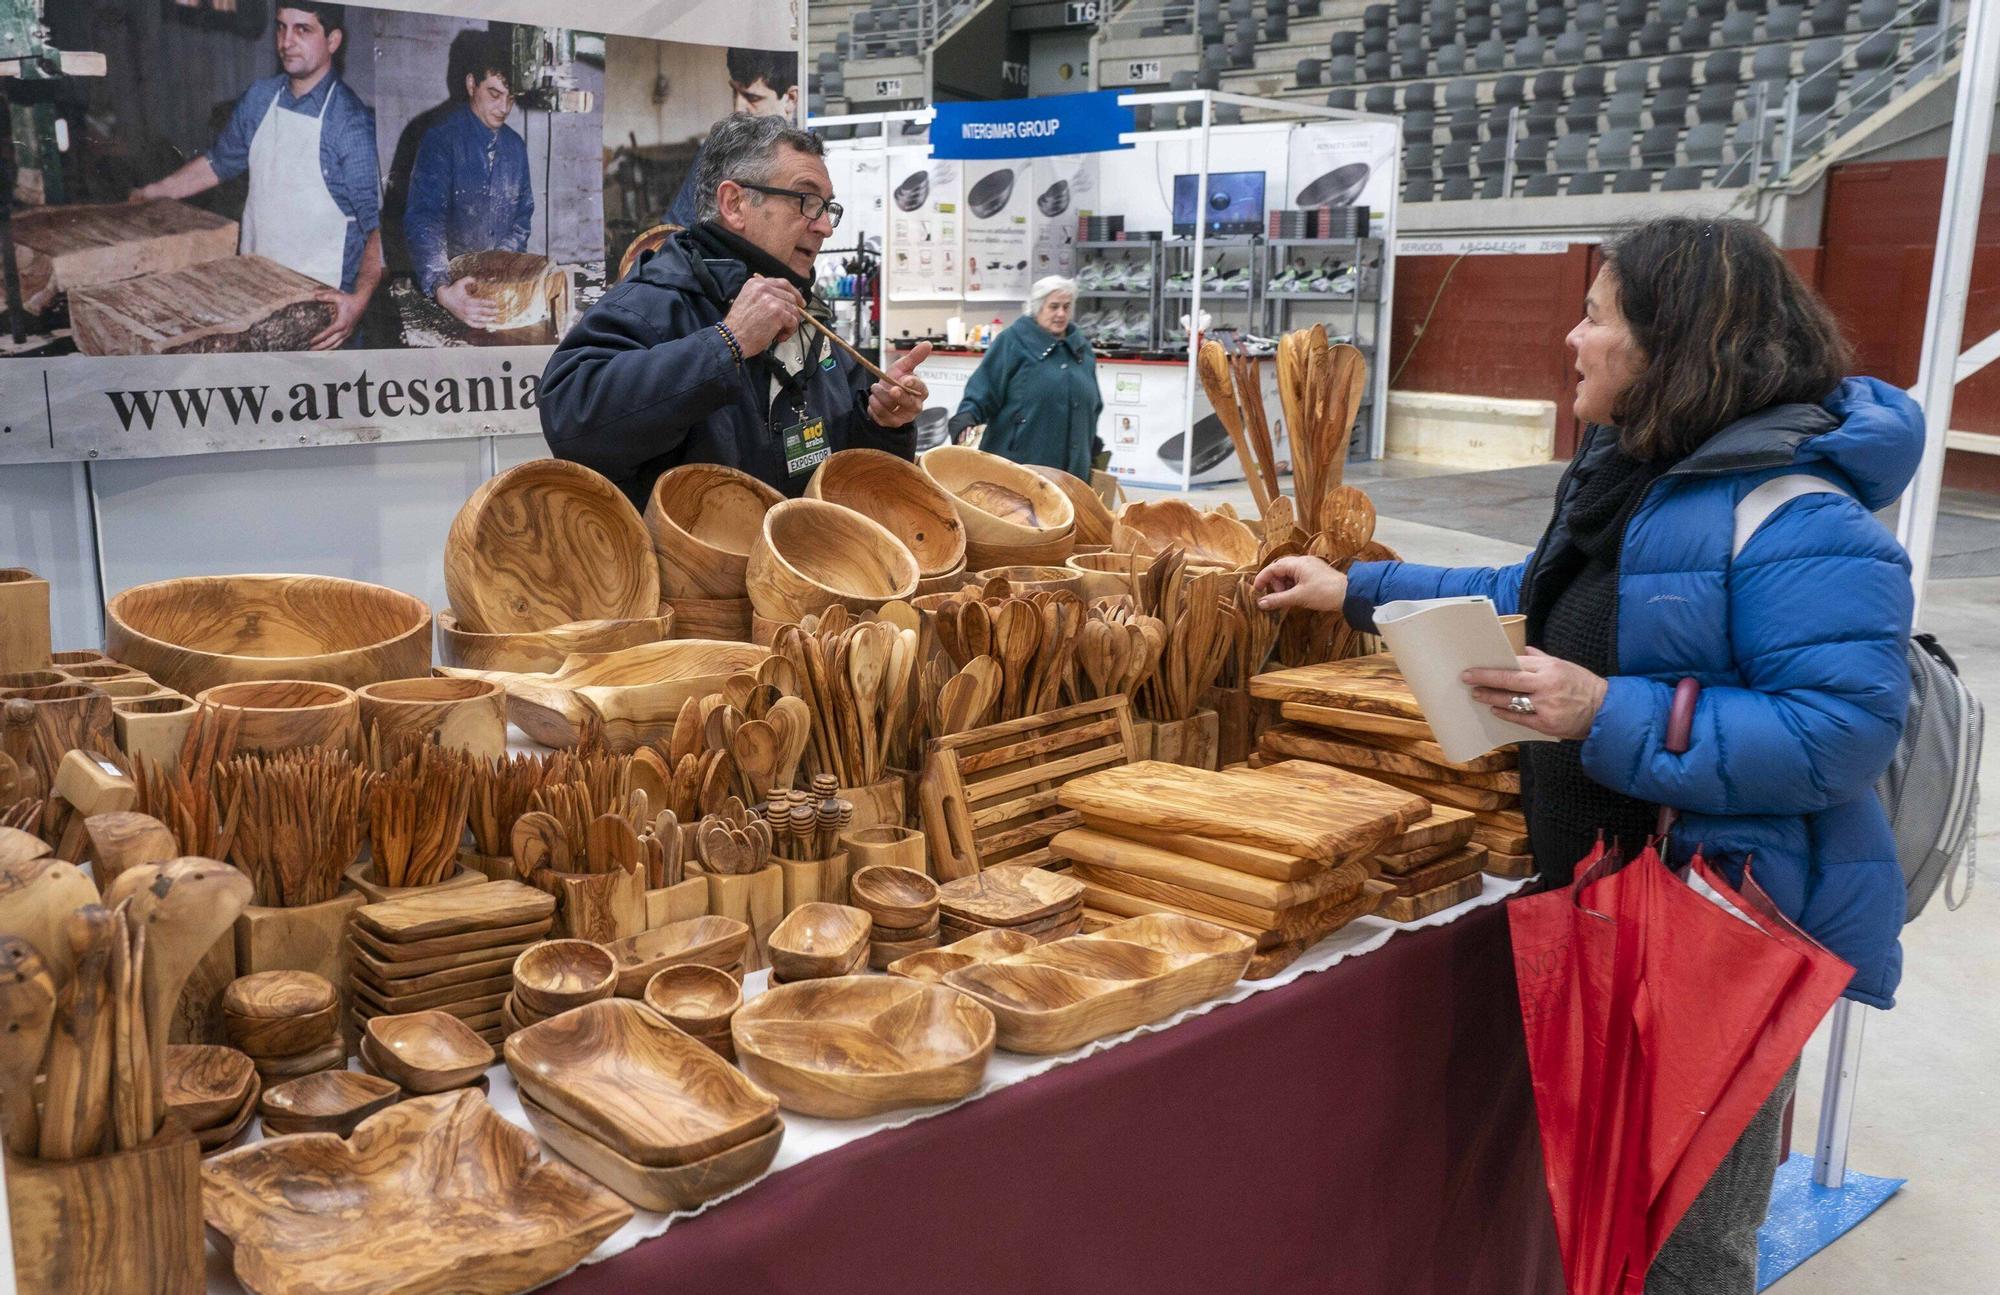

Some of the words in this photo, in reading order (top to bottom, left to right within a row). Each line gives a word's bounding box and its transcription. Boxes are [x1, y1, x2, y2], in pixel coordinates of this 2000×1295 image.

[1073, 3, 1096, 22] T6
[1145, 63, 1158, 72] T6
[962, 121, 1016, 139] INTERGIMAR
[1016, 119, 1060, 138] GROUP
[791, 450, 832, 473] EXPOSITOR
